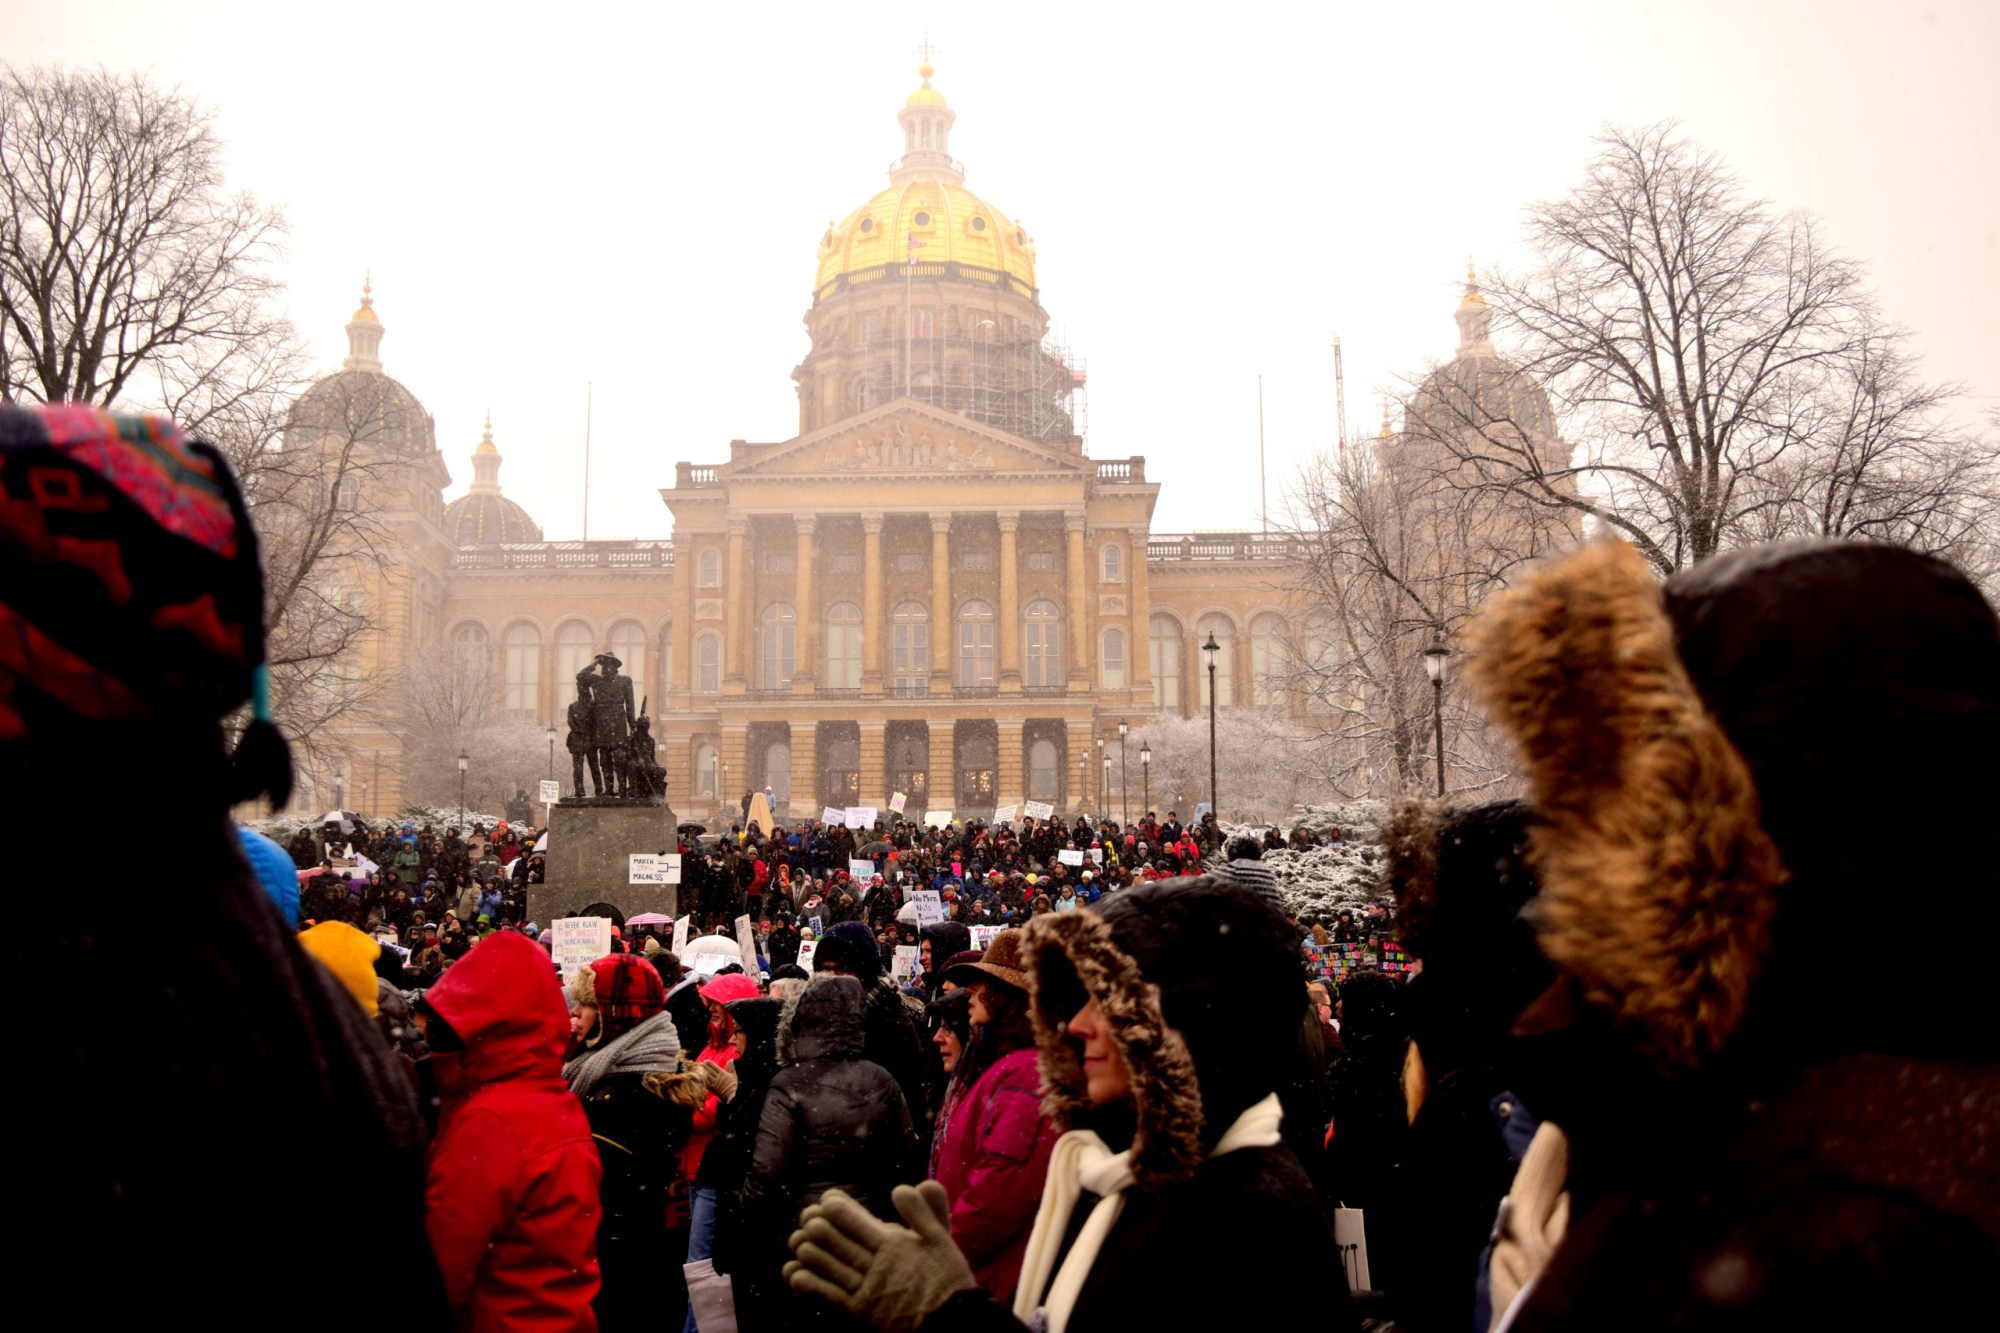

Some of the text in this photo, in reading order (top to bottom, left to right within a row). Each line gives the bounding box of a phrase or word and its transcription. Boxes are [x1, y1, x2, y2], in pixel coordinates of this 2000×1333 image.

[633, 873, 664, 881] MADNESS
[913, 893, 937, 902] No More
[564, 920, 597, 929] NEVER AGAIN
[564, 937, 580, 945] NUNCA
[1385, 951, 1395, 960] IS
